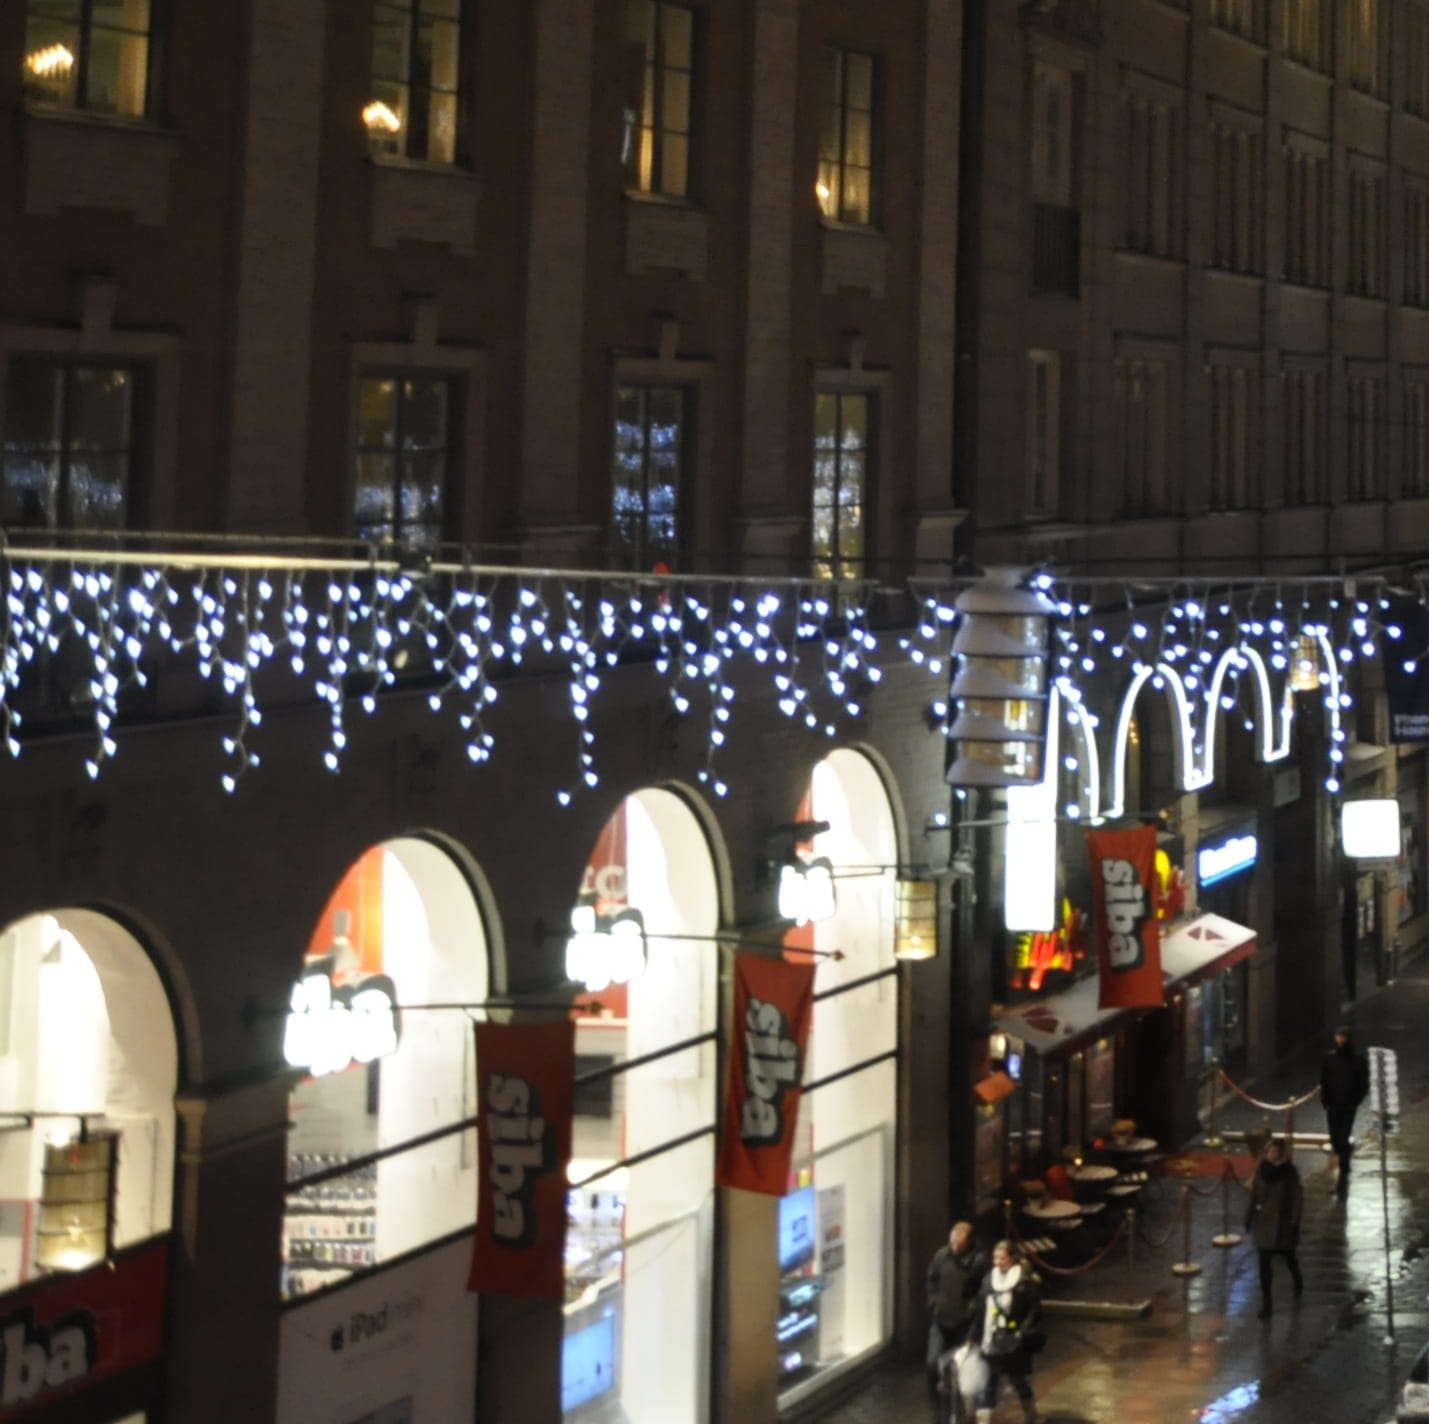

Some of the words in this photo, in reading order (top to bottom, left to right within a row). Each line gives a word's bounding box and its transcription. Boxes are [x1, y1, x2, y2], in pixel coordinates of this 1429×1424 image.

[1101, 857, 1147, 970] siba
[739, 996, 800, 1139] siba
[486, 1071, 546, 1241] siba
